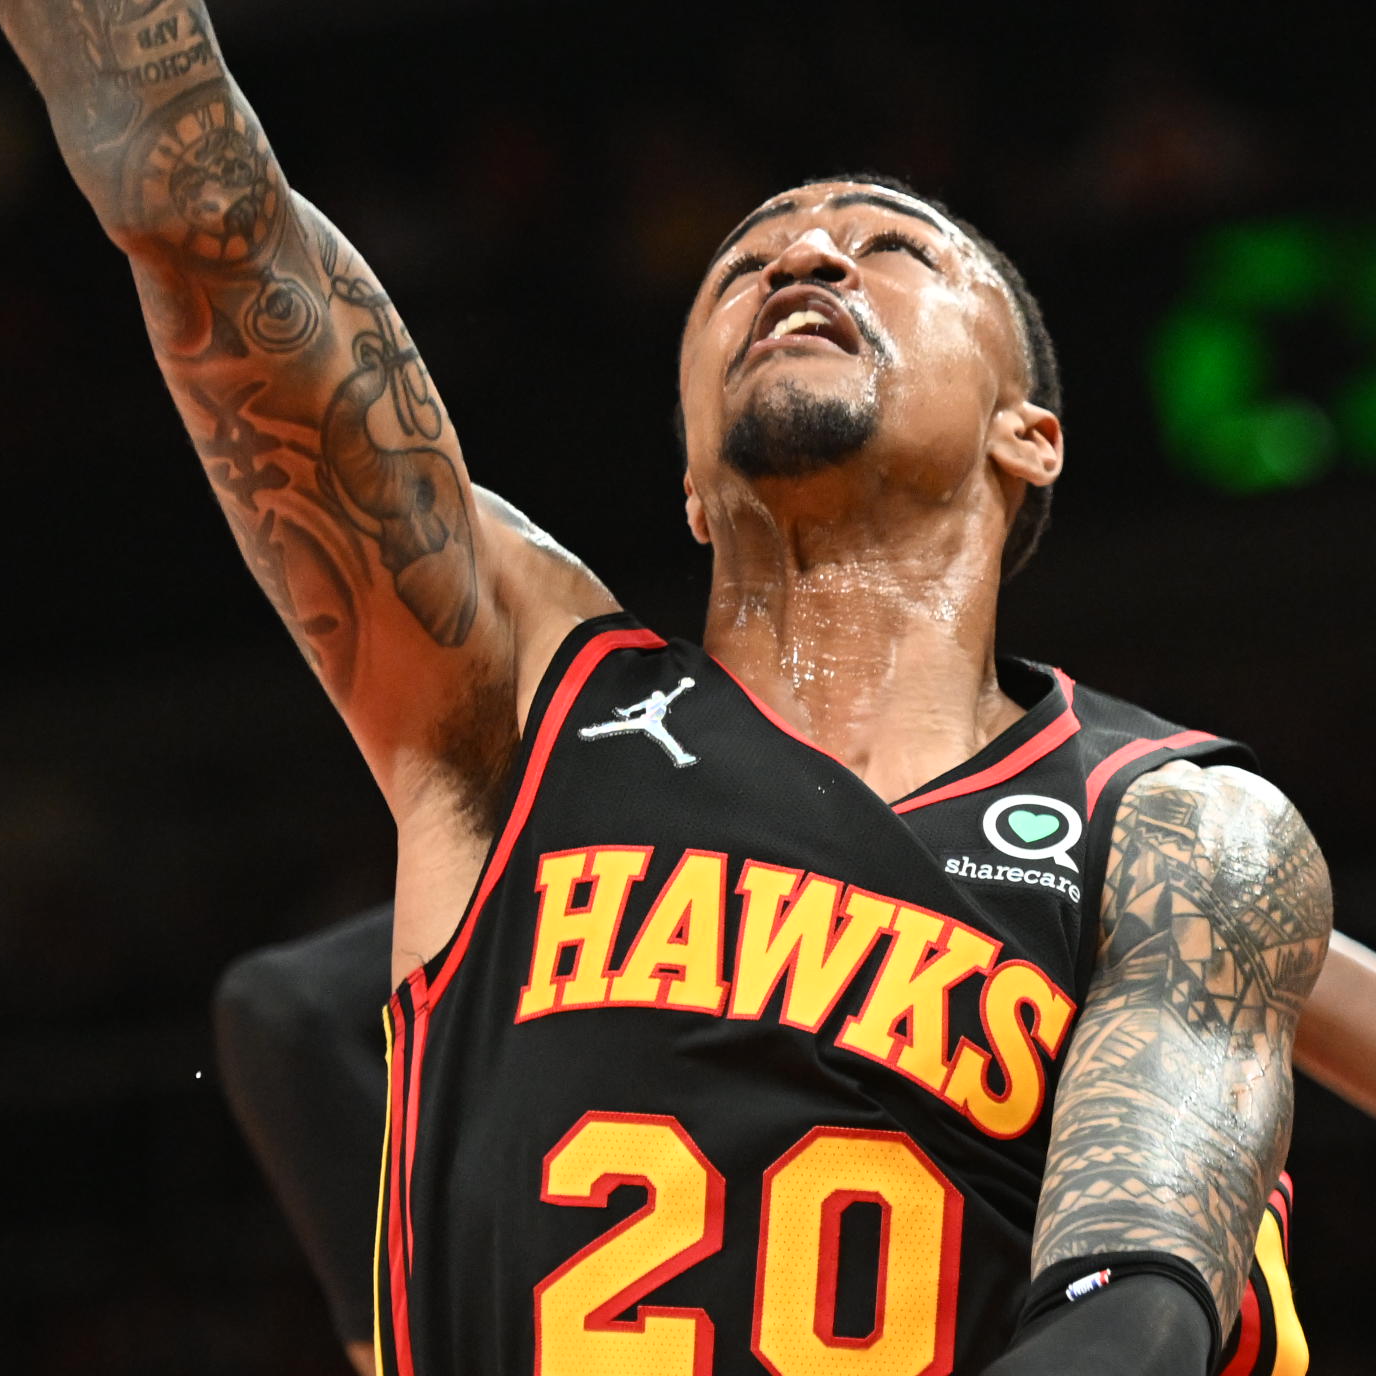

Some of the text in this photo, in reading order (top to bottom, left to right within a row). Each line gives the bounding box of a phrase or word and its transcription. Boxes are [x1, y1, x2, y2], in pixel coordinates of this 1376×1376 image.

[514, 845, 1076, 1140] HAWKS
[944, 855, 1081, 904] sharecare
[533, 1110, 964, 1376] 20
